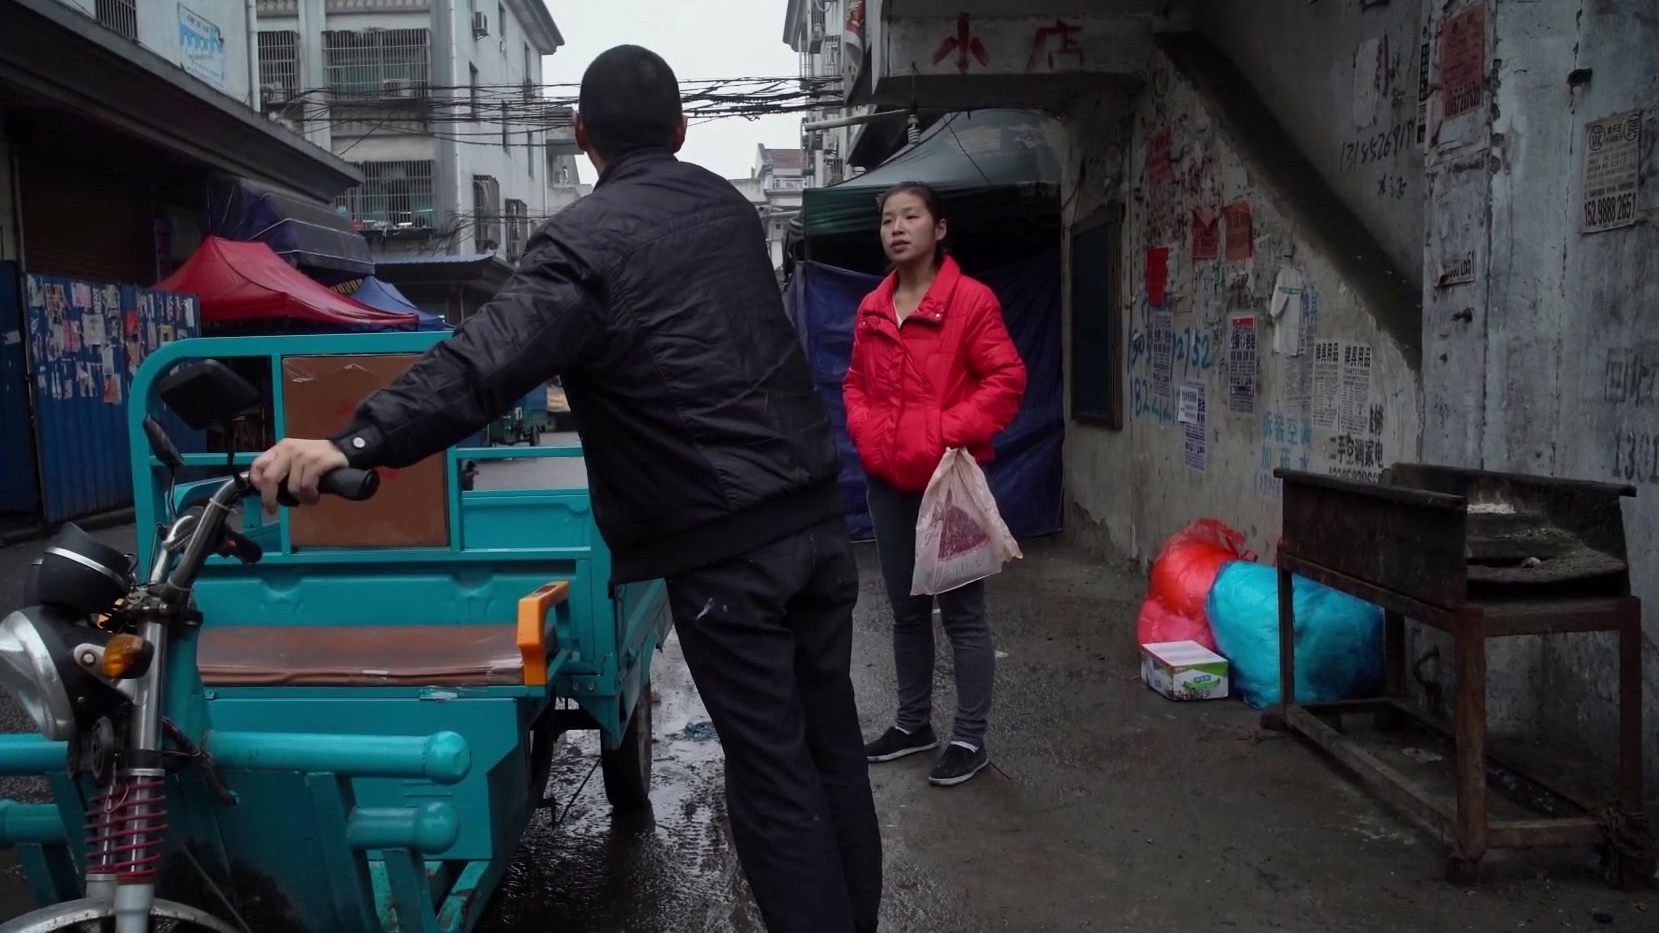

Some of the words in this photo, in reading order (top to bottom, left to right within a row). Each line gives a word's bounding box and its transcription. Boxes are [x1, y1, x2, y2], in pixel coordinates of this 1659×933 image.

[932, 13, 1084, 74] 小店
[1584, 200, 1597, 227] 152
[1597, 196, 1616, 225] 9888
[1617, 192, 1637, 221] 2651
[1329, 434, 1385, 469] 二手空调家电
